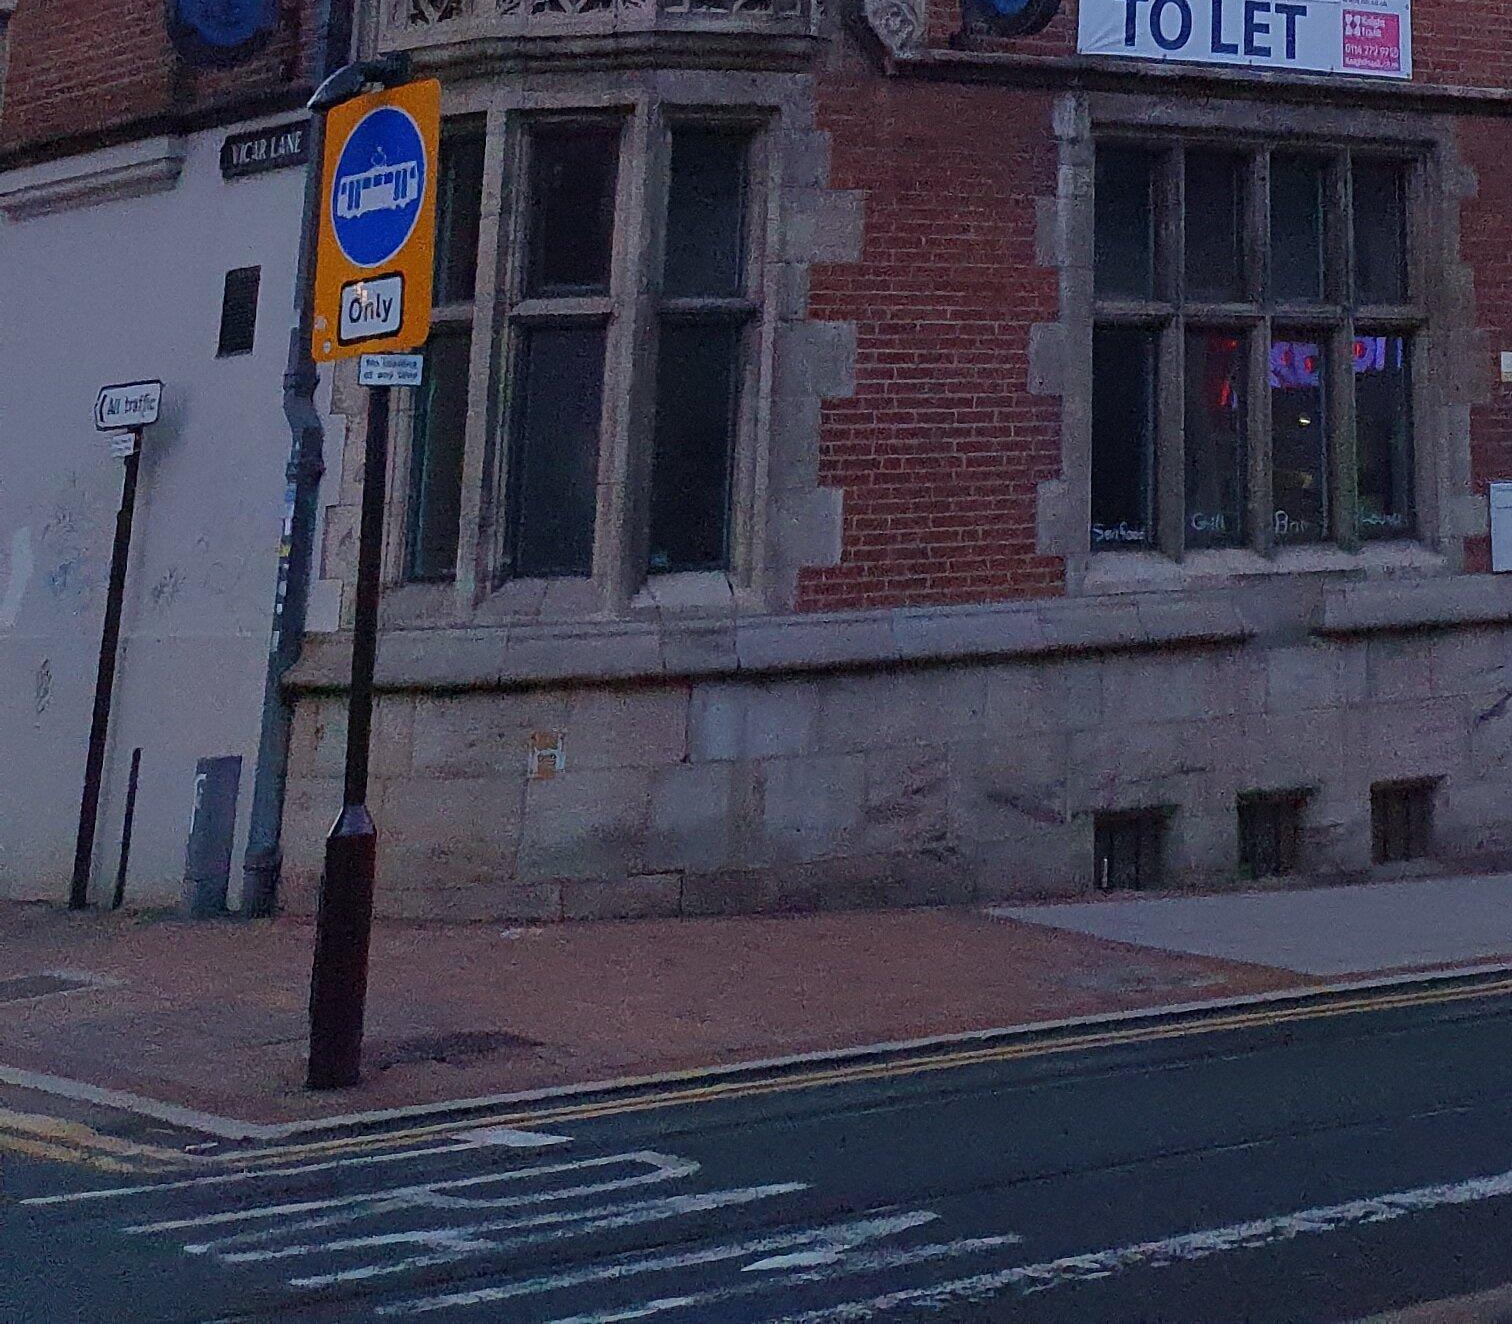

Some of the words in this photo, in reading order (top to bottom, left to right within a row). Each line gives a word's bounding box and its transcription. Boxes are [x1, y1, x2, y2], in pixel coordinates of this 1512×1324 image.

[232, 139, 268, 165] VICAR
[270, 131, 302, 158] LANE
[348, 295, 393, 324] Only
[107, 397, 121, 415] All
[124, 394, 157, 414] traffic
